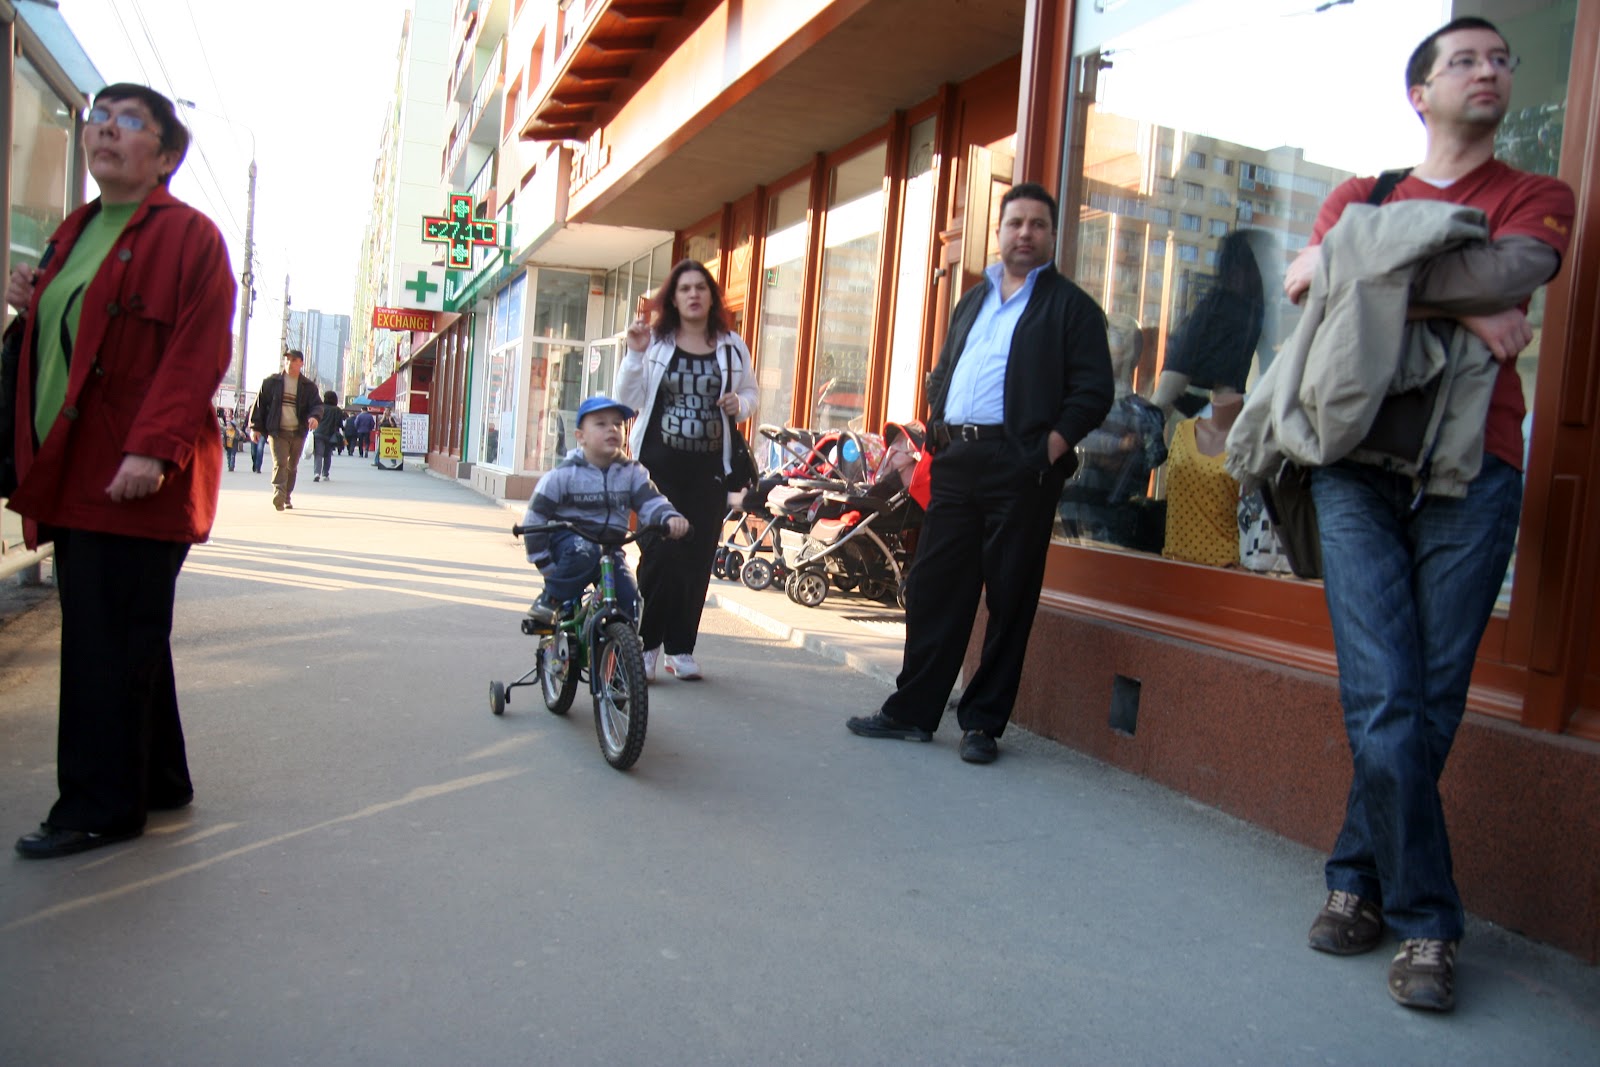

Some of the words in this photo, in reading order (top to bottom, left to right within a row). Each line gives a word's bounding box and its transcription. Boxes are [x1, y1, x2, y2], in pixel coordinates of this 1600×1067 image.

[377, 313, 429, 331] EXCHANGE
[661, 372, 721, 396] NIC
[664, 405, 697, 419] WHO
[661, 413, 722, 440] COO
[385, 446, 398, 456] 0%
